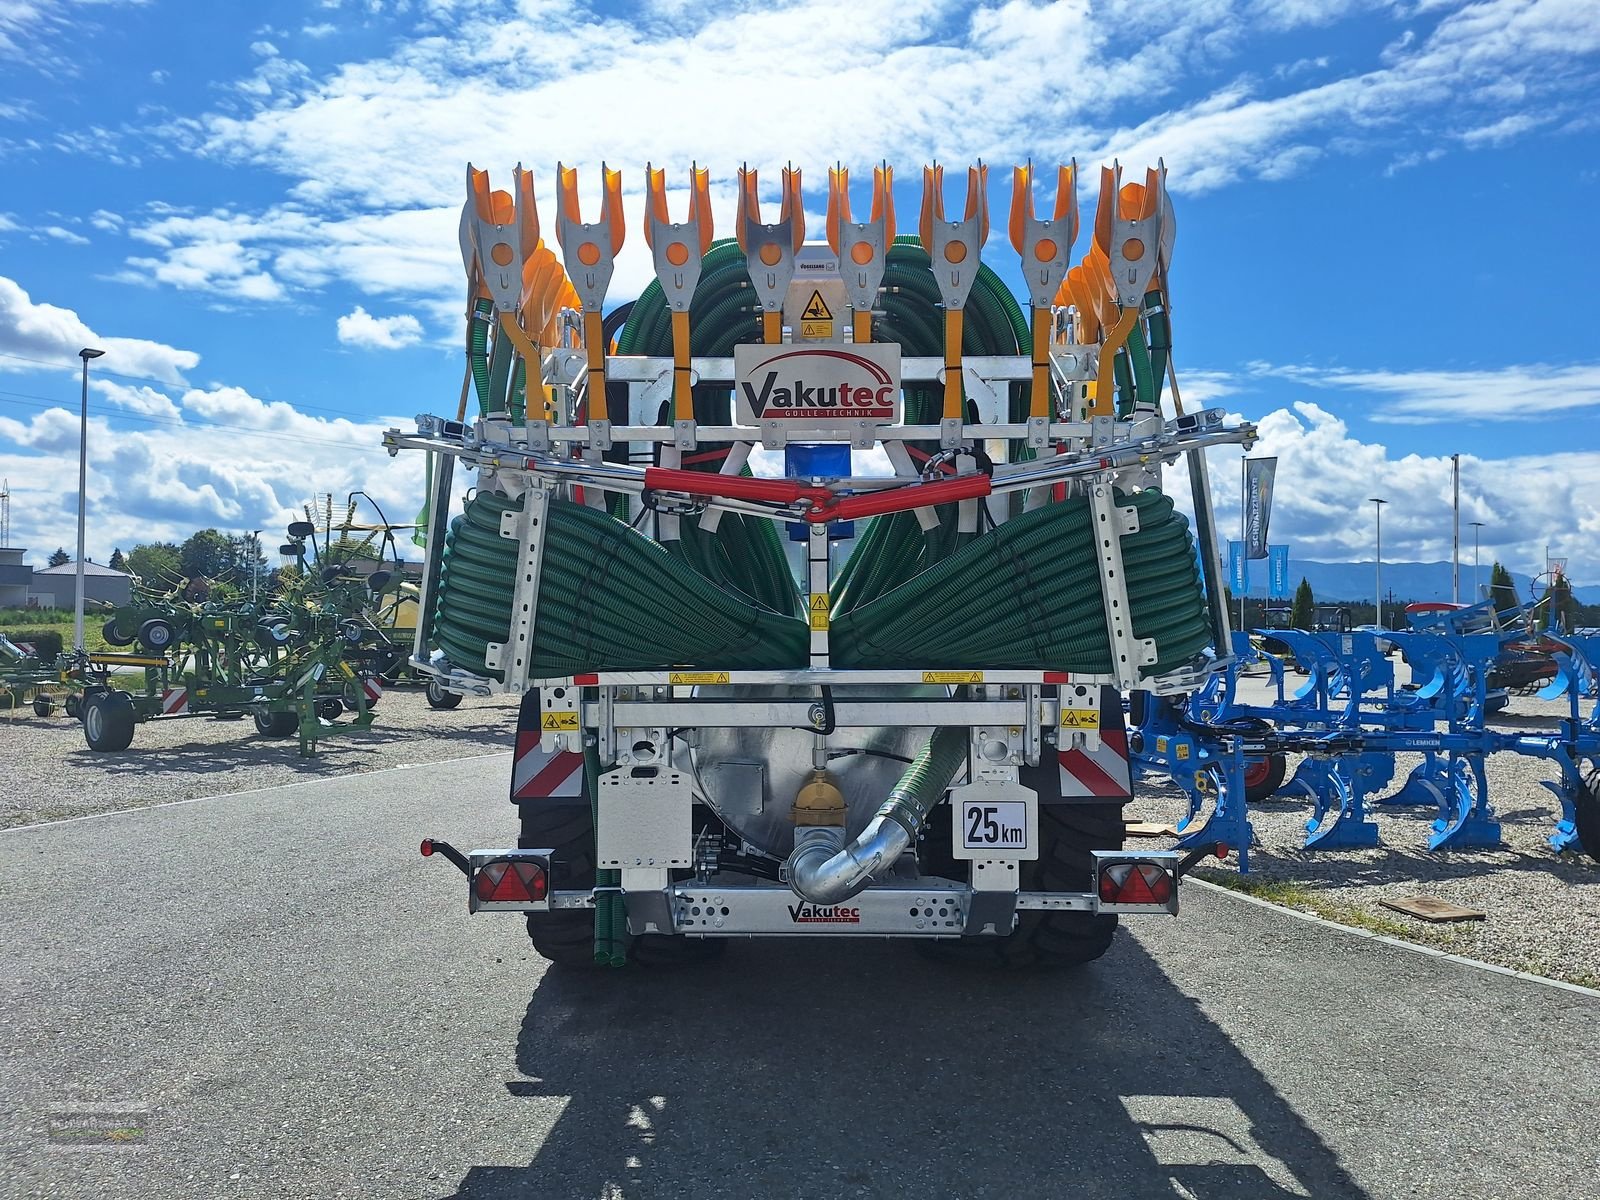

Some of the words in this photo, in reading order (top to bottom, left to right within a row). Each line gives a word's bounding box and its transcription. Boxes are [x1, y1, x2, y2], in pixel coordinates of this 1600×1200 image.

[741, 372, 894, 418] Vakutec
[968, 807, 999, 843] 25
[1002, 824, 1022, 843] km
[788, 900, 860, 922] Vakutec
